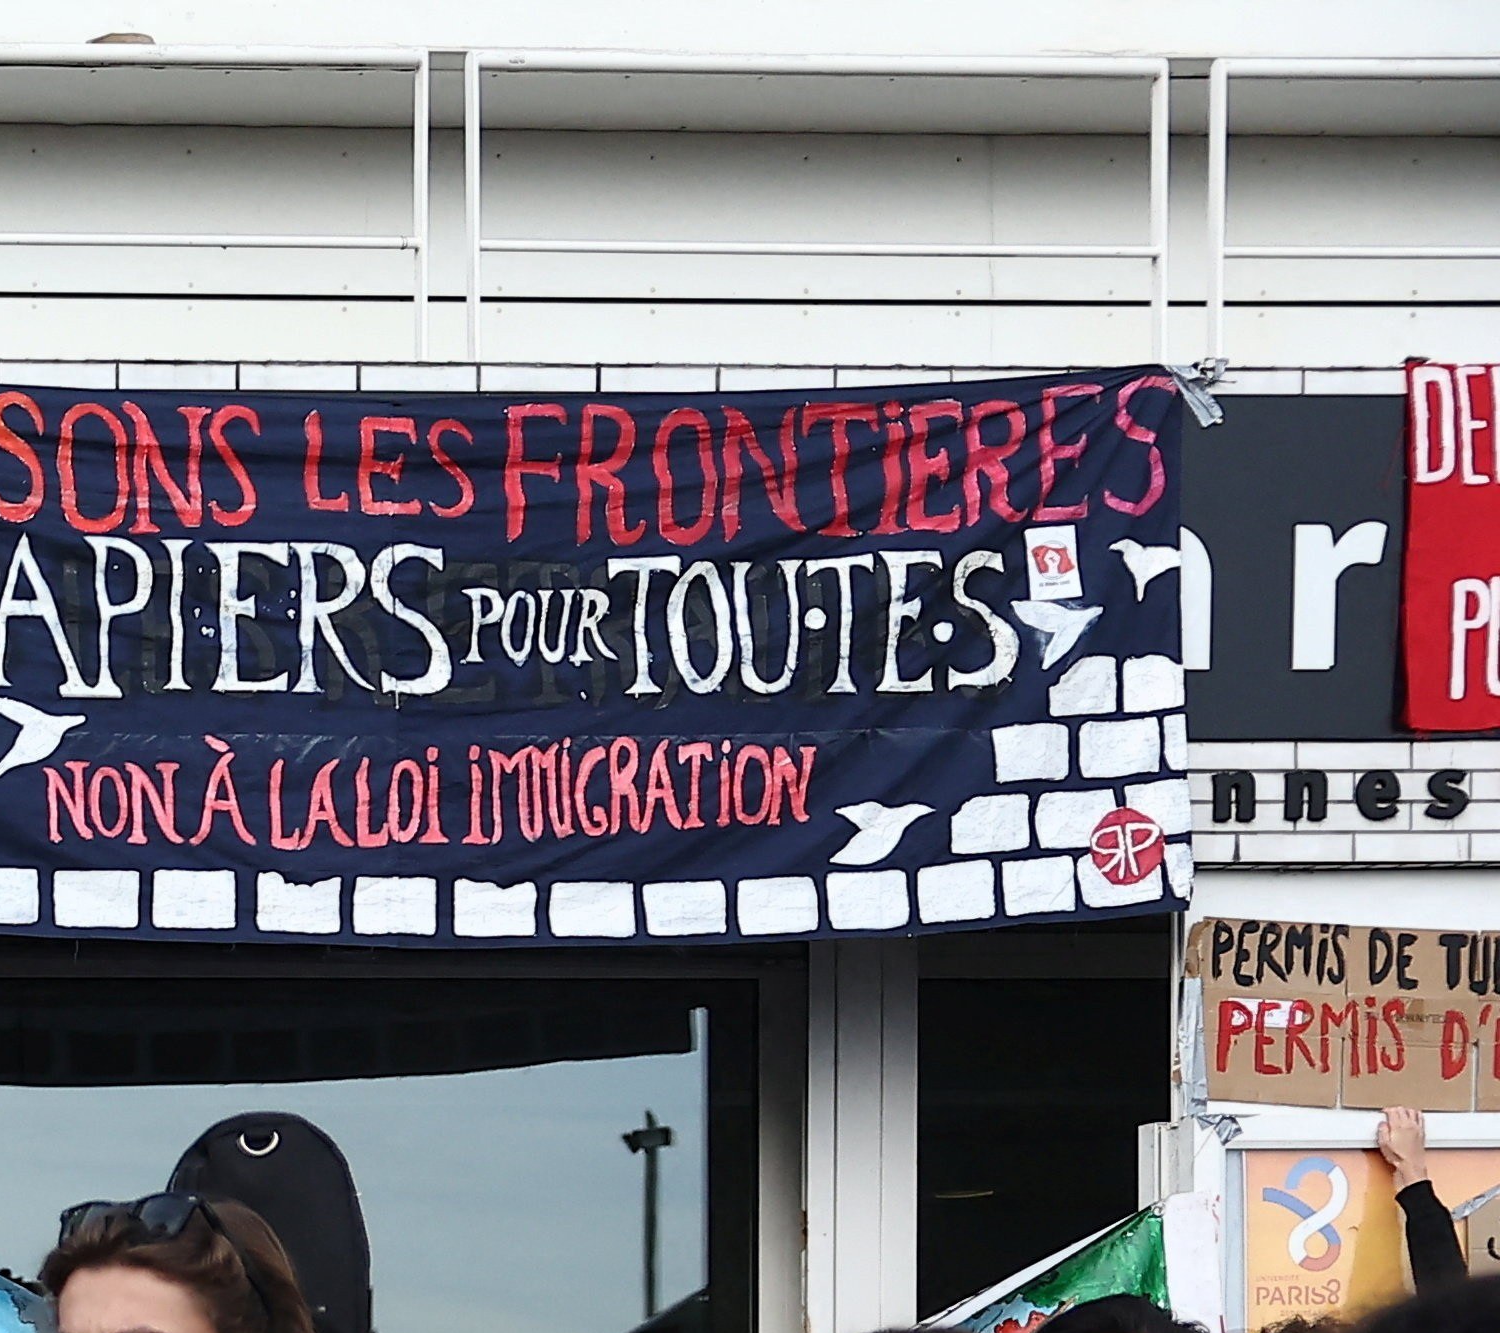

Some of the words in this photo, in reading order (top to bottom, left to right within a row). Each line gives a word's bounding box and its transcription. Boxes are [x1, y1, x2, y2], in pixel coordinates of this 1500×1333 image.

[304, 408, 475, 518] LES
[461, 586, 618, 667] POUR
[43, 759, 184, 845] NON
[190, 735, 257, 847] À
[1368, 927, 1419, 990] DE
